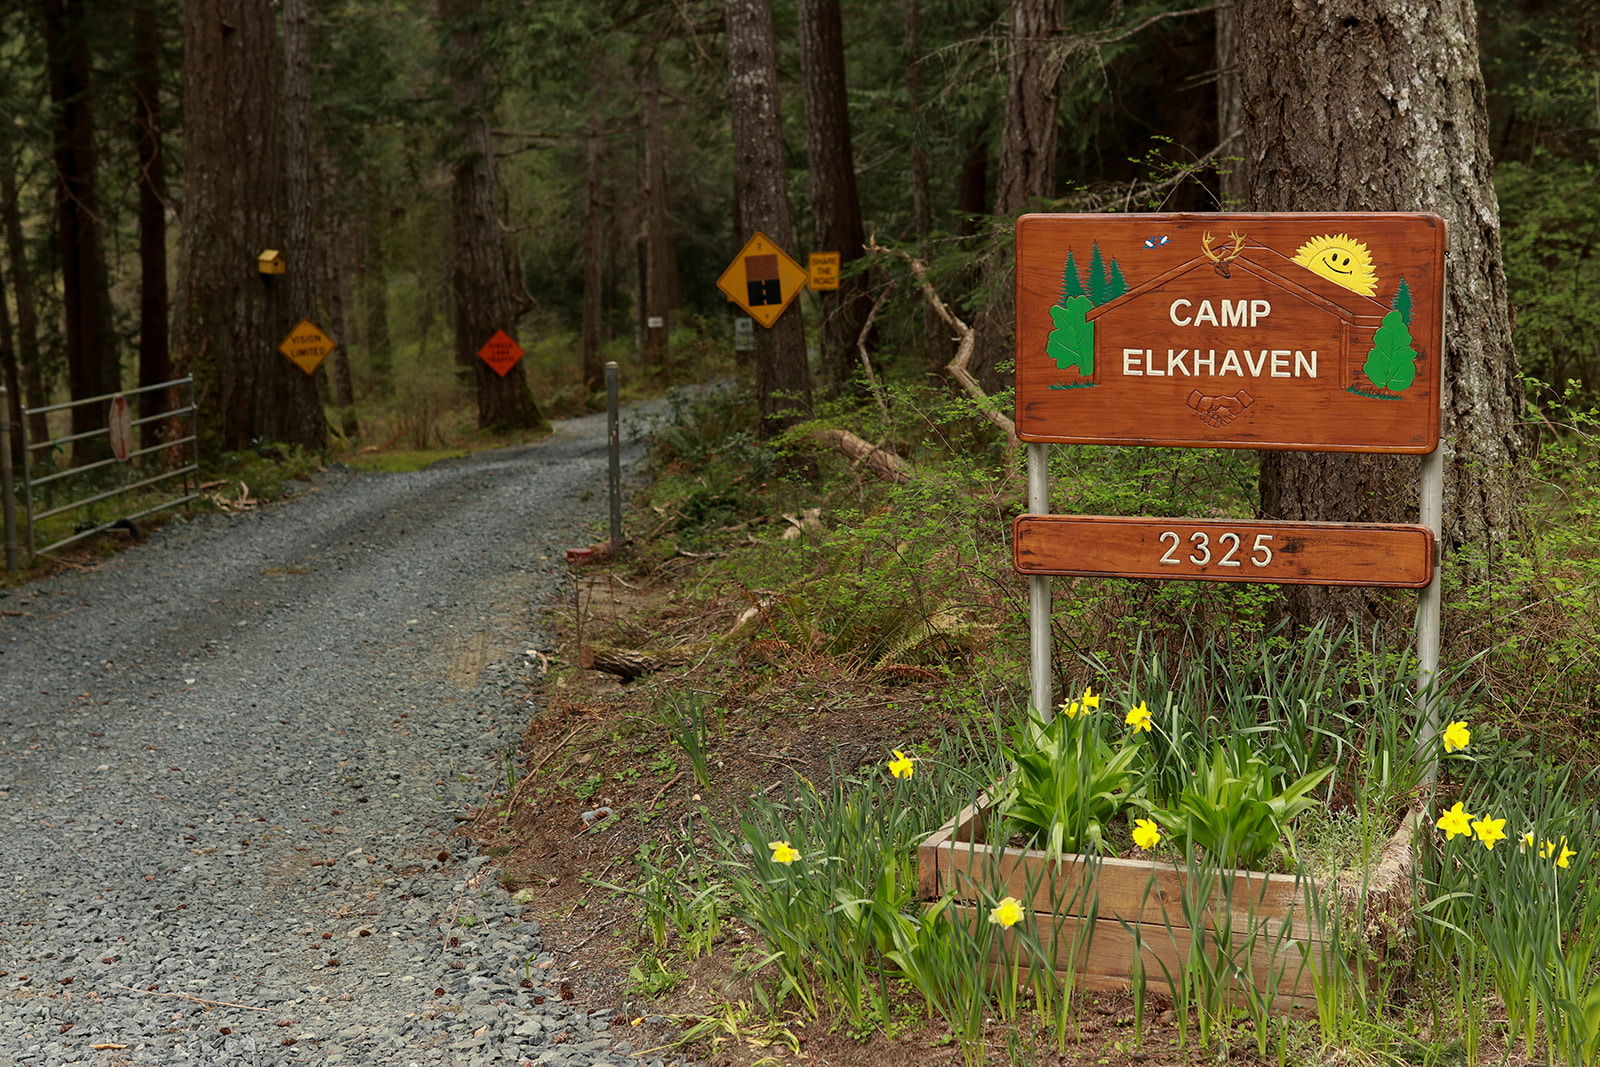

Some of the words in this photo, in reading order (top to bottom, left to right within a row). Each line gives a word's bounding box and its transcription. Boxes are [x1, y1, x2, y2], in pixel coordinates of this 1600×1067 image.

[812, 257, 836, 265] SHARE
[816, 267, 832, 275] THE
[814, 277, 835, 285] ROAD
[1169, 299, 1271, 328] CAMP
[291, 335, 321, 344] VISION
[290, 347, 325, 357] LIMITED
[1122, 348, 1318, 379] ELKHAVEN
[1158, 531, 1274, 568] 2325
